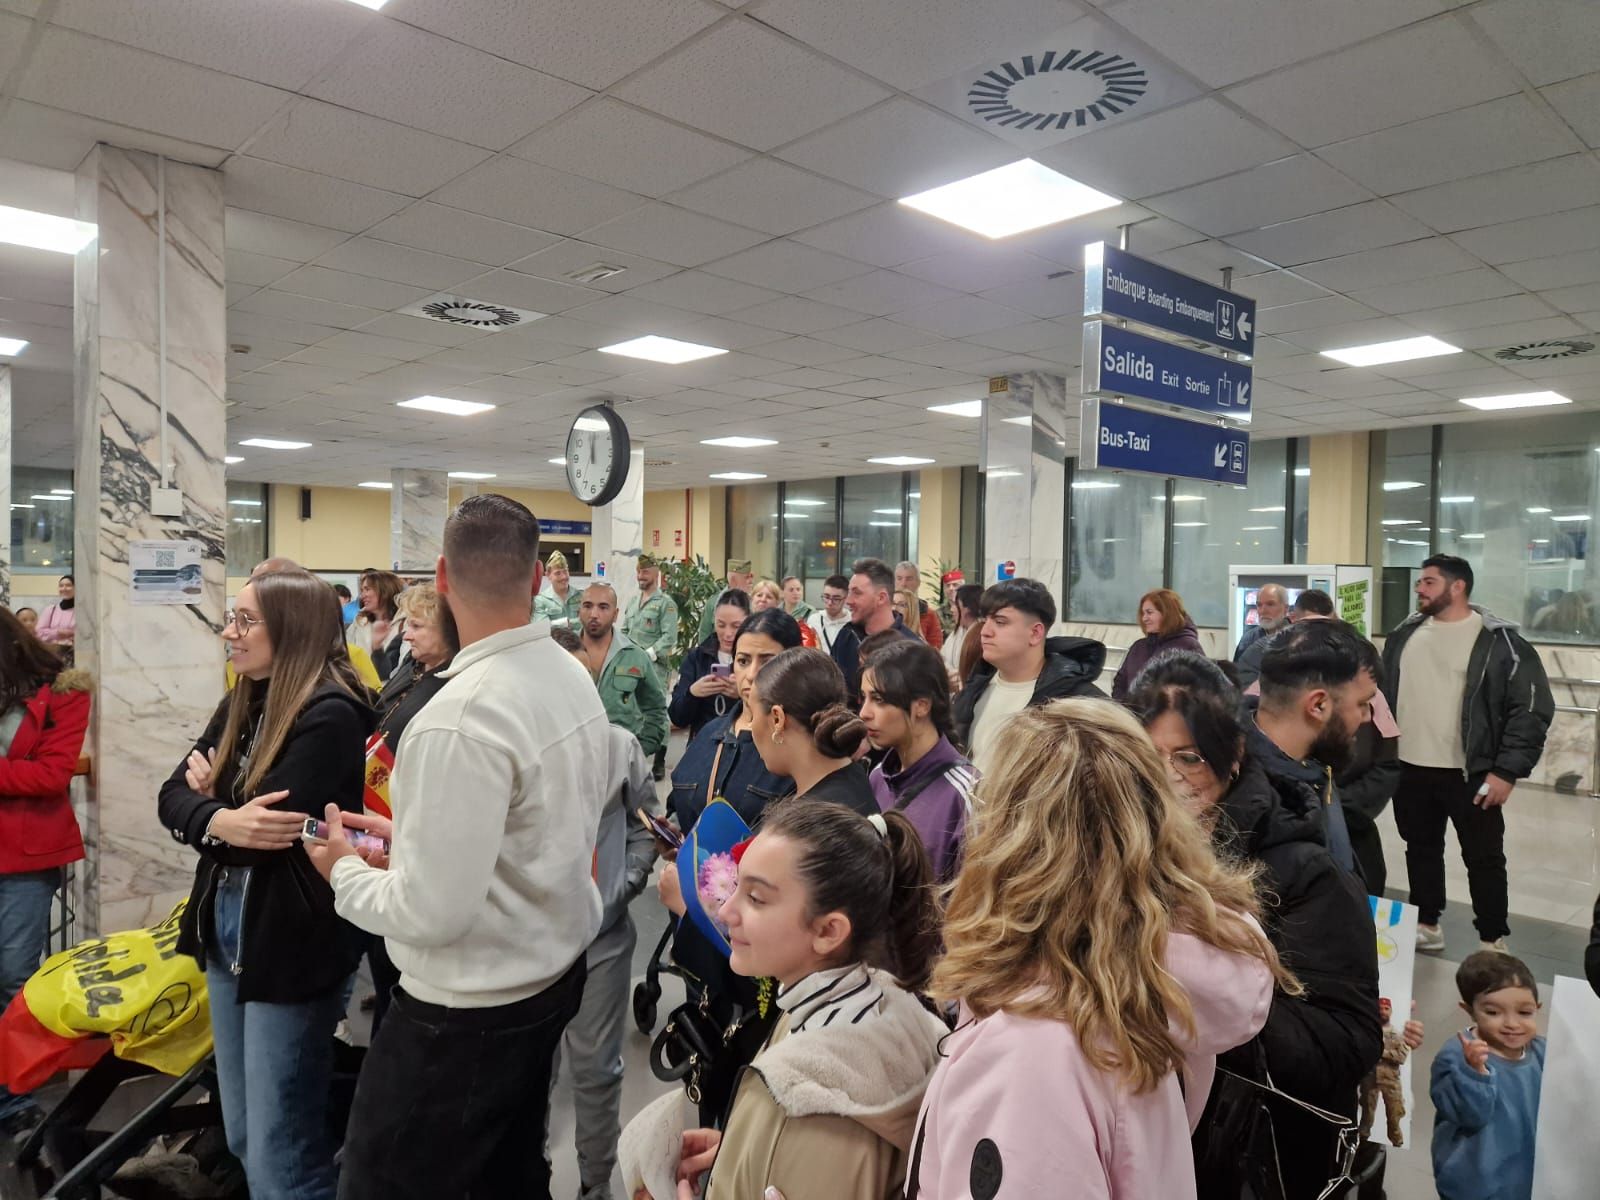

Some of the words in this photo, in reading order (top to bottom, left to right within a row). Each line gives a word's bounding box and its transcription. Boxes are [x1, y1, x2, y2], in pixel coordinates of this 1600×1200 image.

[1106, 268, 1146, 303] Embarque
[1148, 288, 1174, 314] Boarding
[1176, 297, 1215, 324] Embarquement
[1104, 346, 1154, 381] Salida
[1162, 370, 1179, 388] Exit
[1185, 377, 1210, 395] Sortie
[576, 439, 583, 448] 10
[1101, 426, 1150, 452] Bus-Taxi
[574, 454, 579, 463] 9
[576, 469, 581, 478] 8
[583, 480, 588, 489] 7
[600, 478, 607, 488] 5
[591, 485, 596, 494] 6
